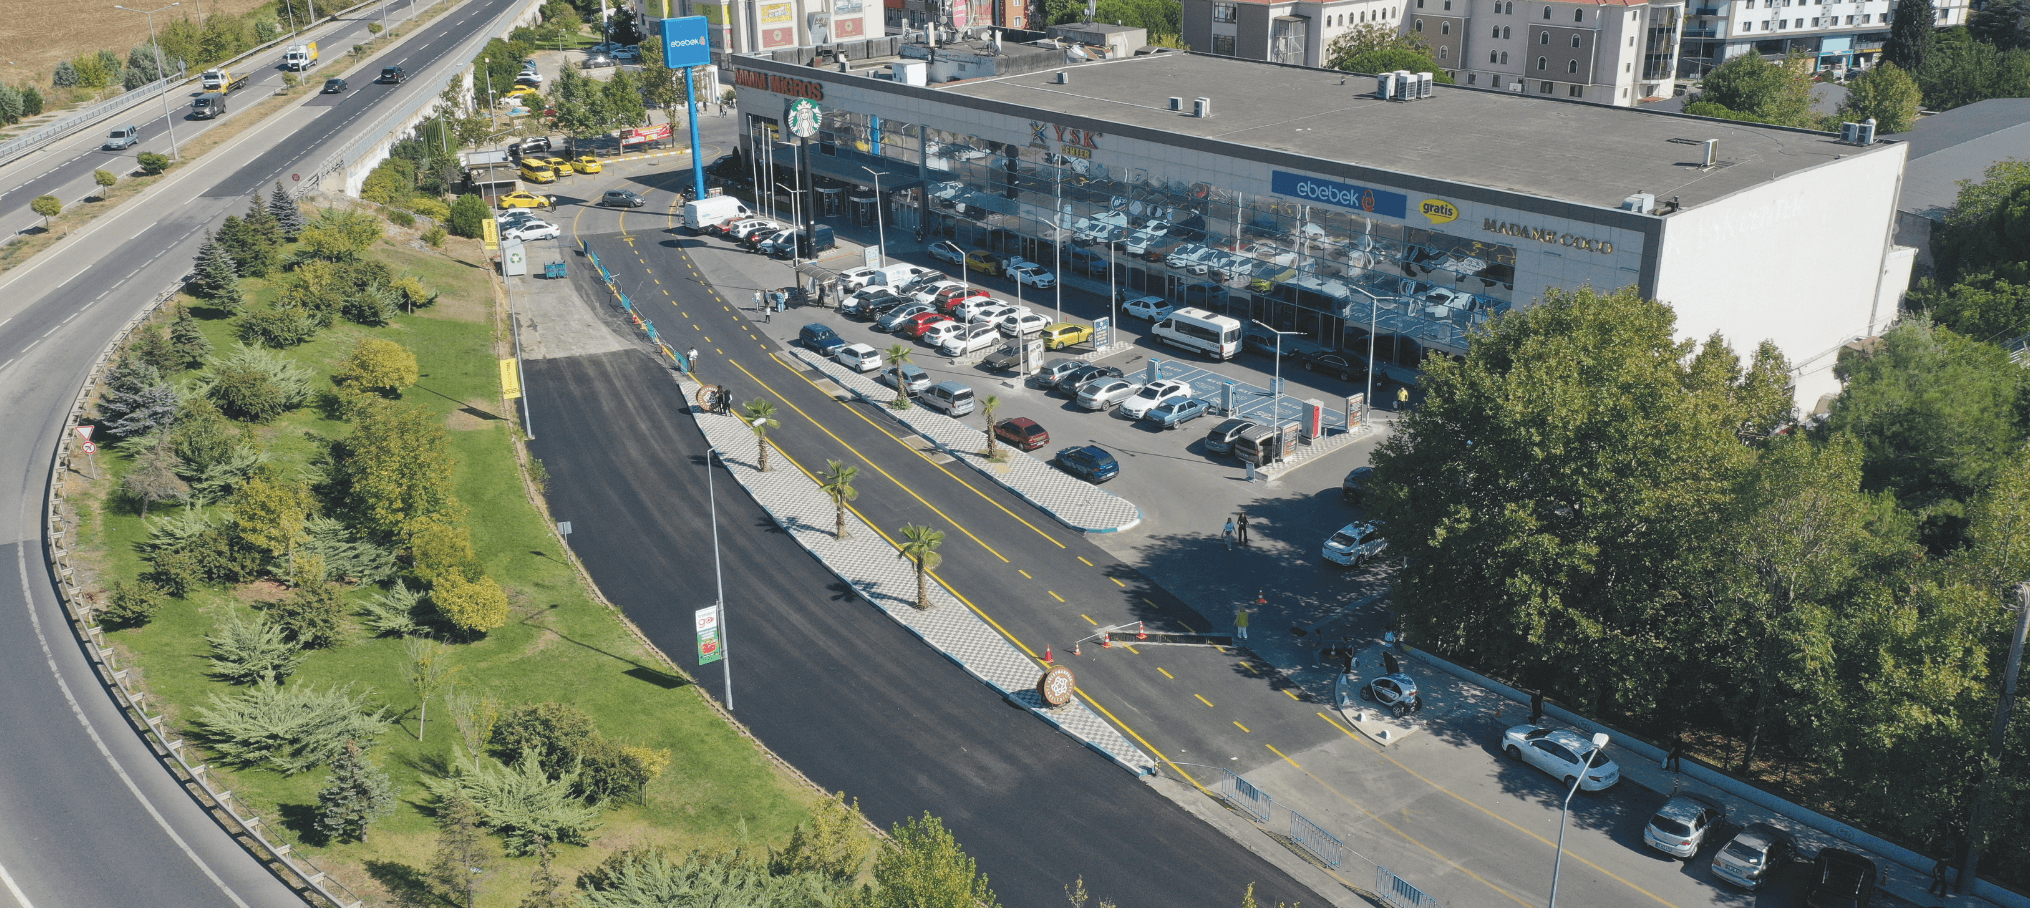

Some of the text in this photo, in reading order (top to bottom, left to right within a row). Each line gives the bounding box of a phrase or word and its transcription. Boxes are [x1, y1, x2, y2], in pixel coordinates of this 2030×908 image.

[671, 38, 699, 47] ebebek
[1053, 124, 1098, 149] YSK
[1061, 145, 1091, 159] CENTER
[1297, 181, 1359, 207] ebebek
[1423, 202, 1453, 217] gratis
[1482, 217, 1613, 255] MADAME COCO
